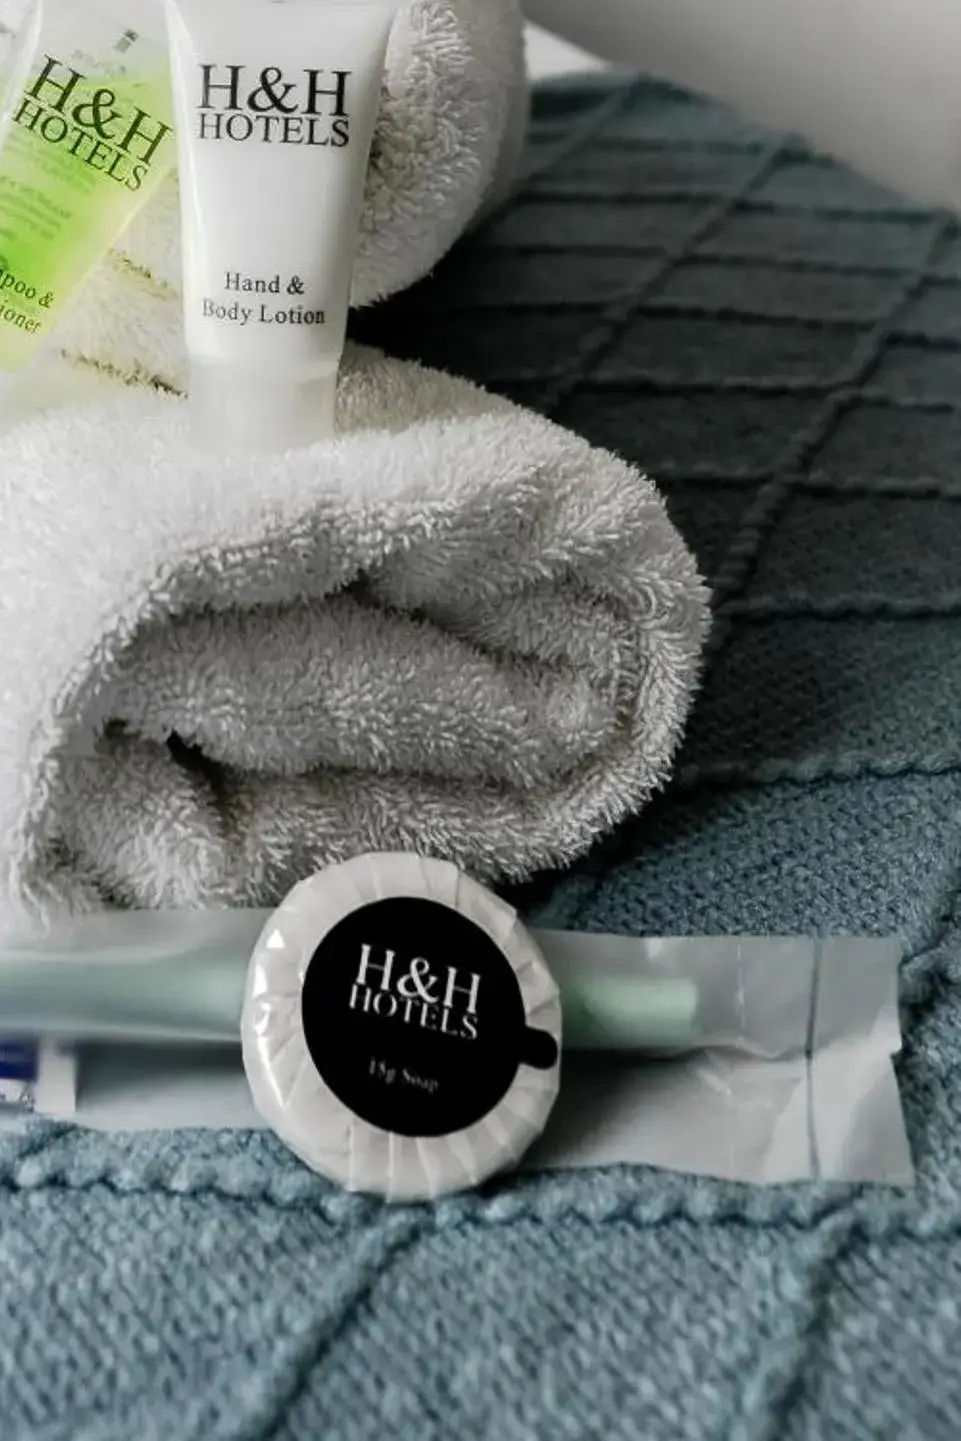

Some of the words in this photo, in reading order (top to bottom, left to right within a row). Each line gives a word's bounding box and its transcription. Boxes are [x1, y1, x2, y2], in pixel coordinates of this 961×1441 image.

[24, 54, 173, 166] H&H
[199, 65, 352, 116] H&H
[12, 98, 148, 192] HOTELS
[198, 116, 350, 148] HOTELS
[38, 291, 54, 309] &
[224, 271, 281, 293] Hand
[286, 274, 305, 295] &
[202, 298, 253, 326] Body
[259, 303, 326, 325] Lotion
[355, 944, 481, 1013] H&H
[349, 984, 478, 1040] HOTELS
